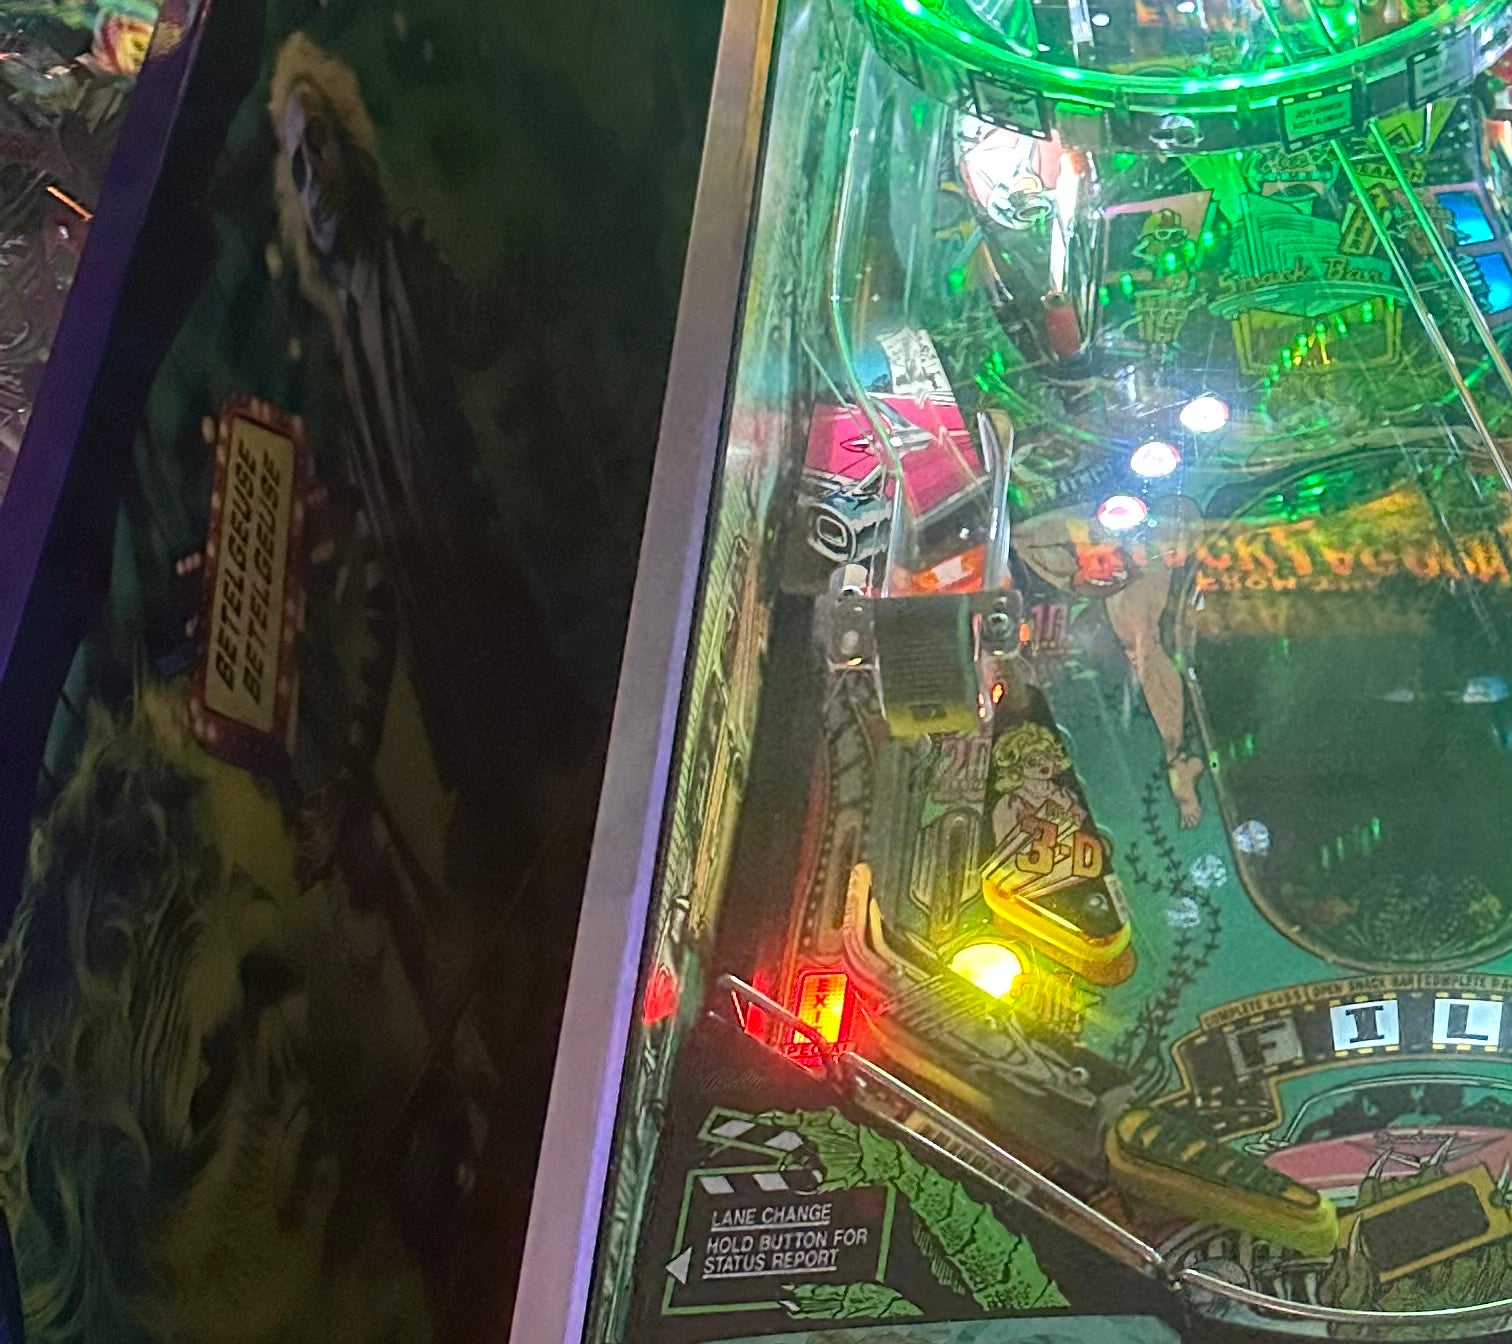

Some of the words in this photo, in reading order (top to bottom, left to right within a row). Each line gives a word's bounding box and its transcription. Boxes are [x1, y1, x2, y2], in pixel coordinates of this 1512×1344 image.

[215, 438, 258, 693] BETELGEUSE
[243, 449, 281, 706] BETELGEUSE
[1015, 813, 1104, 880] 3-D
[711, 1208, 758, 1227] LANE
[761, 1203, 833, 1224] CHANGE
[703, 1254, 767, 1274] STATUS
[770, 1248, 840, 1270] REPORT
[706, 1234, 755, 1255] HOLD
[758, 1231, 828, 1251] BUTTON
[832, 1227, 868, 1246] FOR
